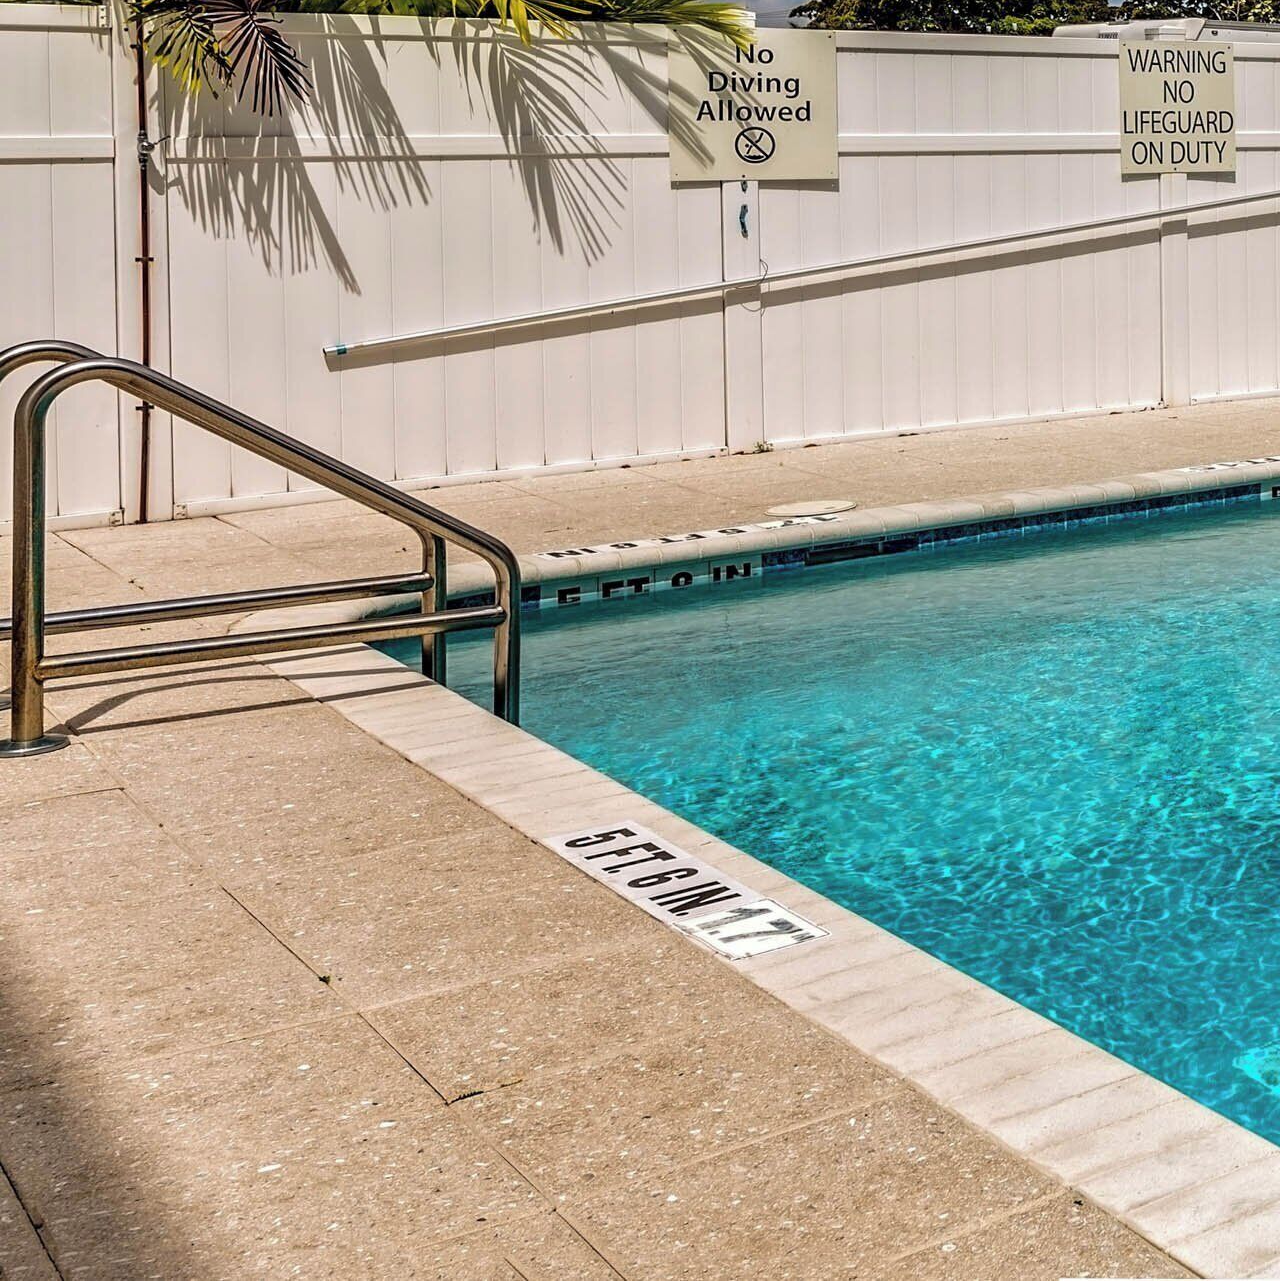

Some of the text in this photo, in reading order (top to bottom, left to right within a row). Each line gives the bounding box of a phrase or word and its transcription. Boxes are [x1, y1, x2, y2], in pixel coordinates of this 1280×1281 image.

[735, 43, 774, 64] No
[1128, 49, 1226, 73] WARNING
[708, 71, 800, 98] Diving
[1163, 80, 1195, 103] NO
[696, 100, 811, 122] Allowed
[1123, 110, 1233, 134] LIFEGUARD
[1131, 140, 1226, 165] ON DUTY
[564, 827, 638, 849] 5
[583, 841, 678, 874] FT.
[627, 867, 699, 888] 6
[649, 881, 742, 916] IN.
